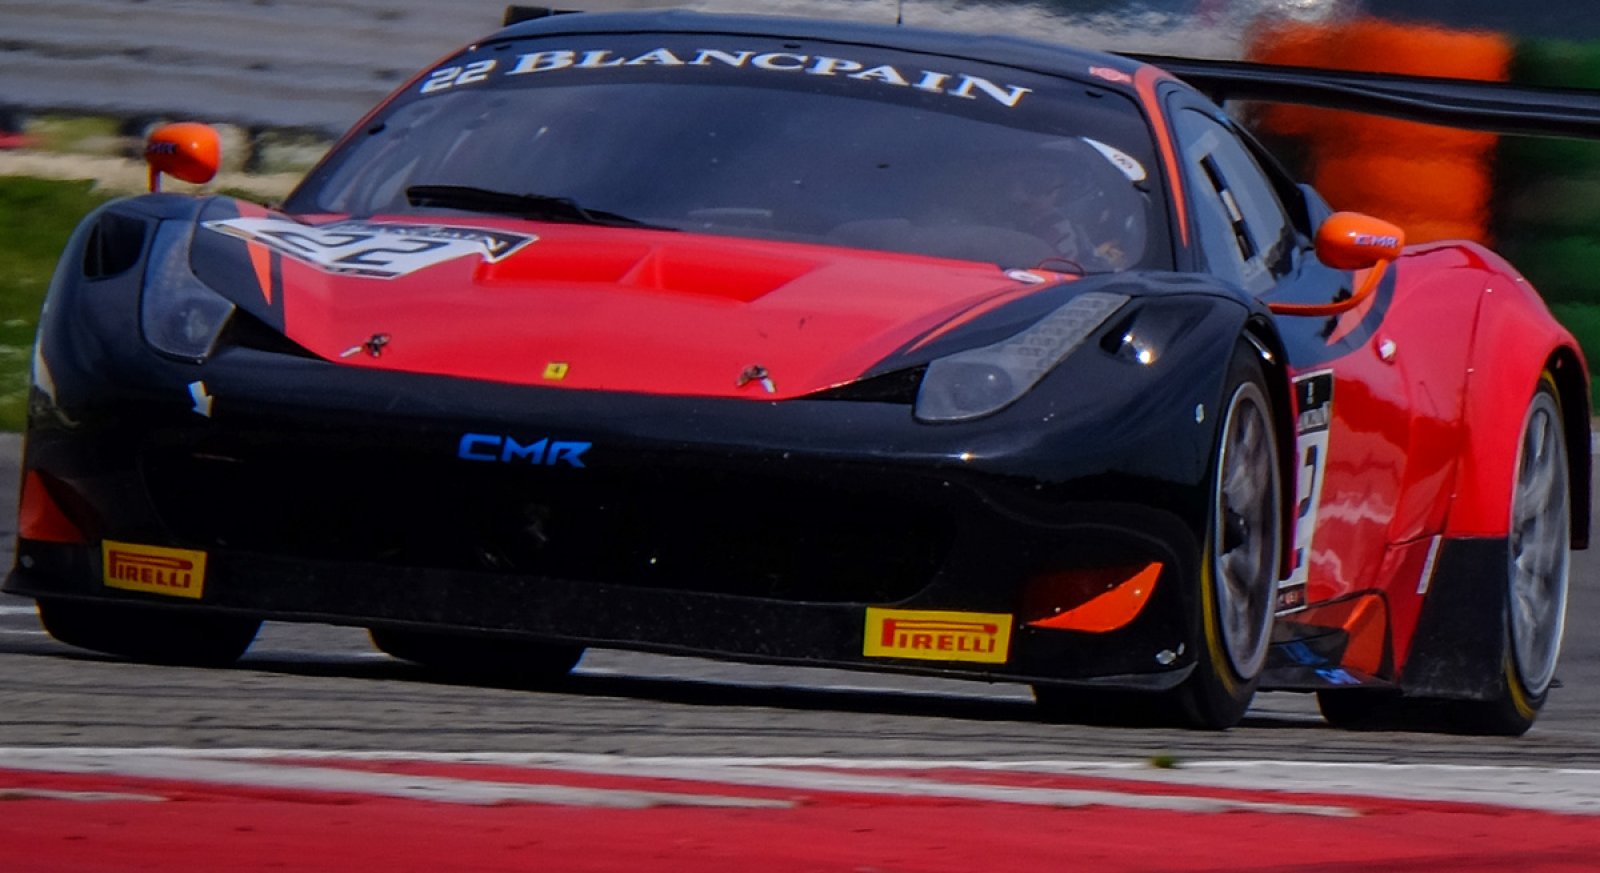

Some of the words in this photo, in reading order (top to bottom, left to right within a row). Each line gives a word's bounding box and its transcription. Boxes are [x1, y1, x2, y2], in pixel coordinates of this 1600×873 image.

[420, 59, 497, 93] 22
[504, 47, 1032, 107] BLANCPAIN
[458, 432, 593, 468] CMR
[108, 549, 193, 588] PIRELLI
[881, 618, 998, 653] PIRELLI
